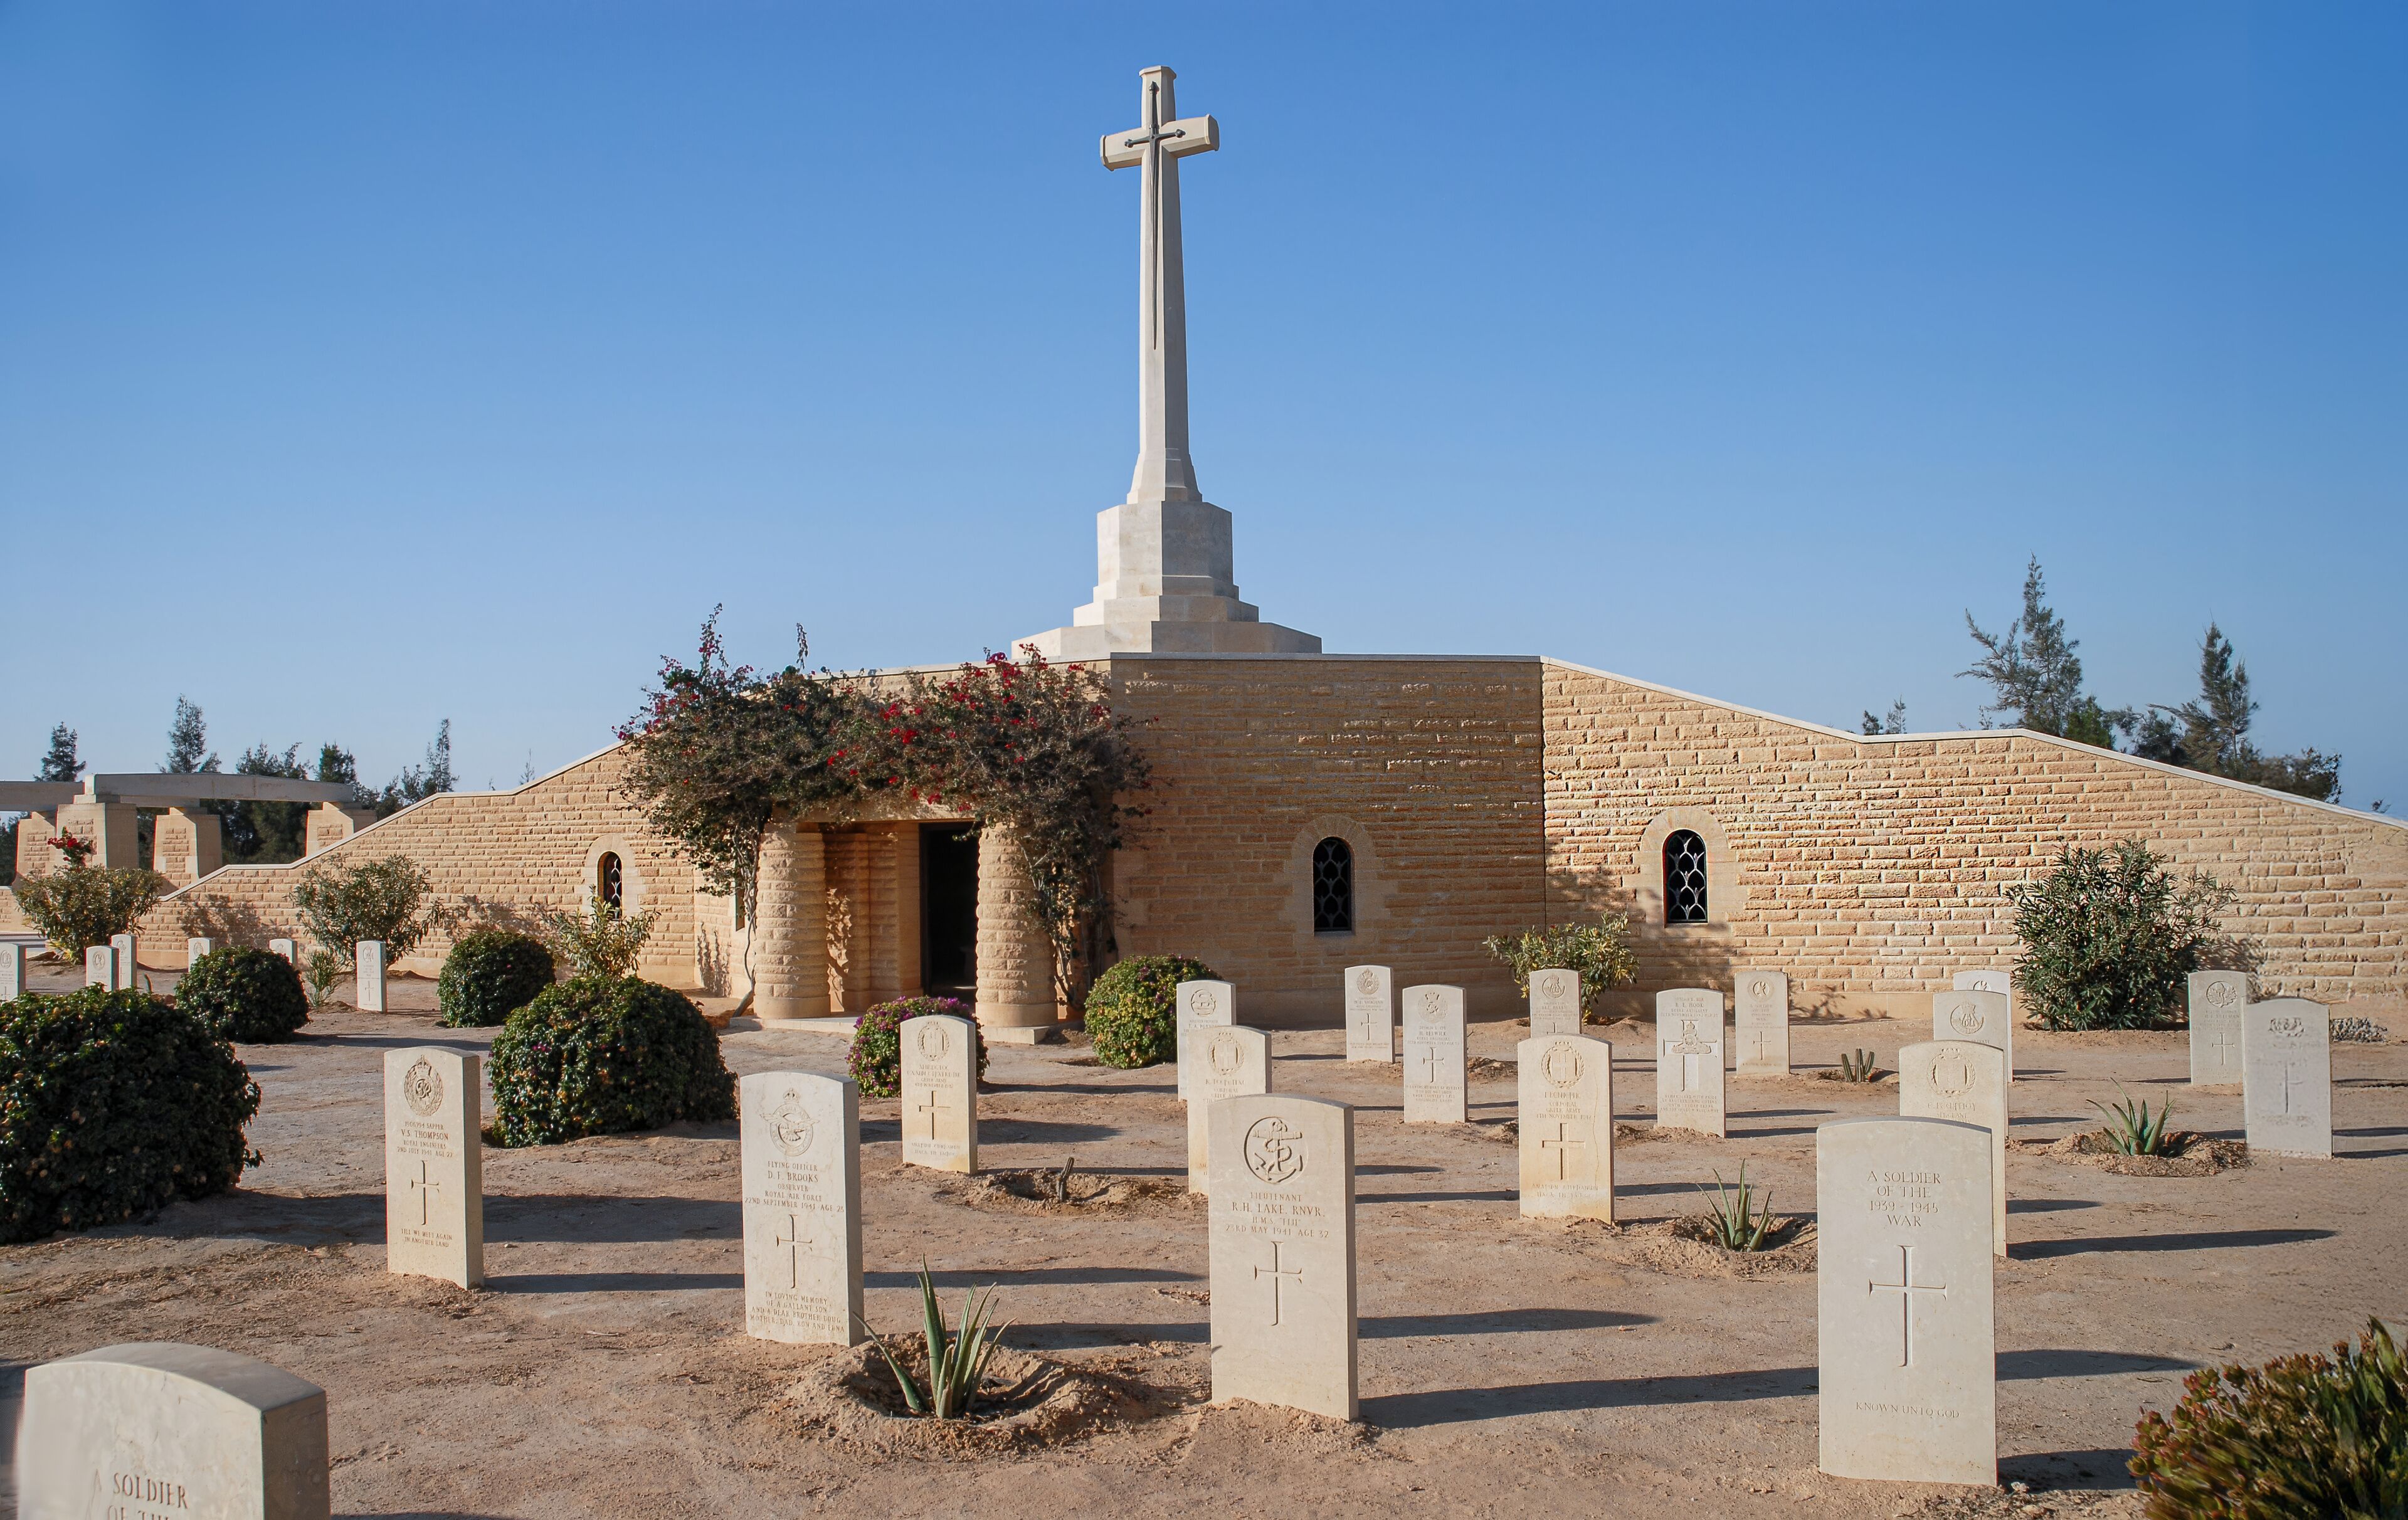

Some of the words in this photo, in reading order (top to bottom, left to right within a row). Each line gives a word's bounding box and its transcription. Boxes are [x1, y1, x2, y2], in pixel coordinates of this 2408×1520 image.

[768, 1161, 790, 1169] FLYING
[792, 1163, 818, 1171] OFFICER
[787, 1172, 819, 1183] BROOKS
[1867, 1170, 1877, 1182] A
[1884, 1171, 1941, 1184] SOLDIER
[777, 1183, 809, 1192] OBSERVER
[1877, 1185, 1894, 1196] OF
[1899, 1186, 1931, 1198] THE
[764, 1190, 784, 1198] ROYAL
[803, 1194, 823, 1202] FORCE
[1250, 1191, 1302, 1202] LIEUTENANT
[763, 1198, 798, 1208] SEPTEMBER
[1869, 1200, 1895, 1211] 1939
[1911, 1202, 1939, 1213] 1945
[1887, 1214, 1921, 1227] WAR
[1250, 1225, 1269, 1234] MAY
[1297, 1228, 1314, 1238] AGE
[774, 1292, 798, 1302] LOVING
[801, 1295, 828, 1305] MEMORY
[783, 1302, 812, 1312] GALLANT
[751, 1306, 764, 1314] AND
[773, 1309, 790, 1317] DEAR
[823, 1315, 841, 1324] DOUG
[1856, 1401, 1899, 1413] KNOWN
[1937, 1409, 1960, 1418] GOD
[113, 1472, 189, 1509] SOLDIER
